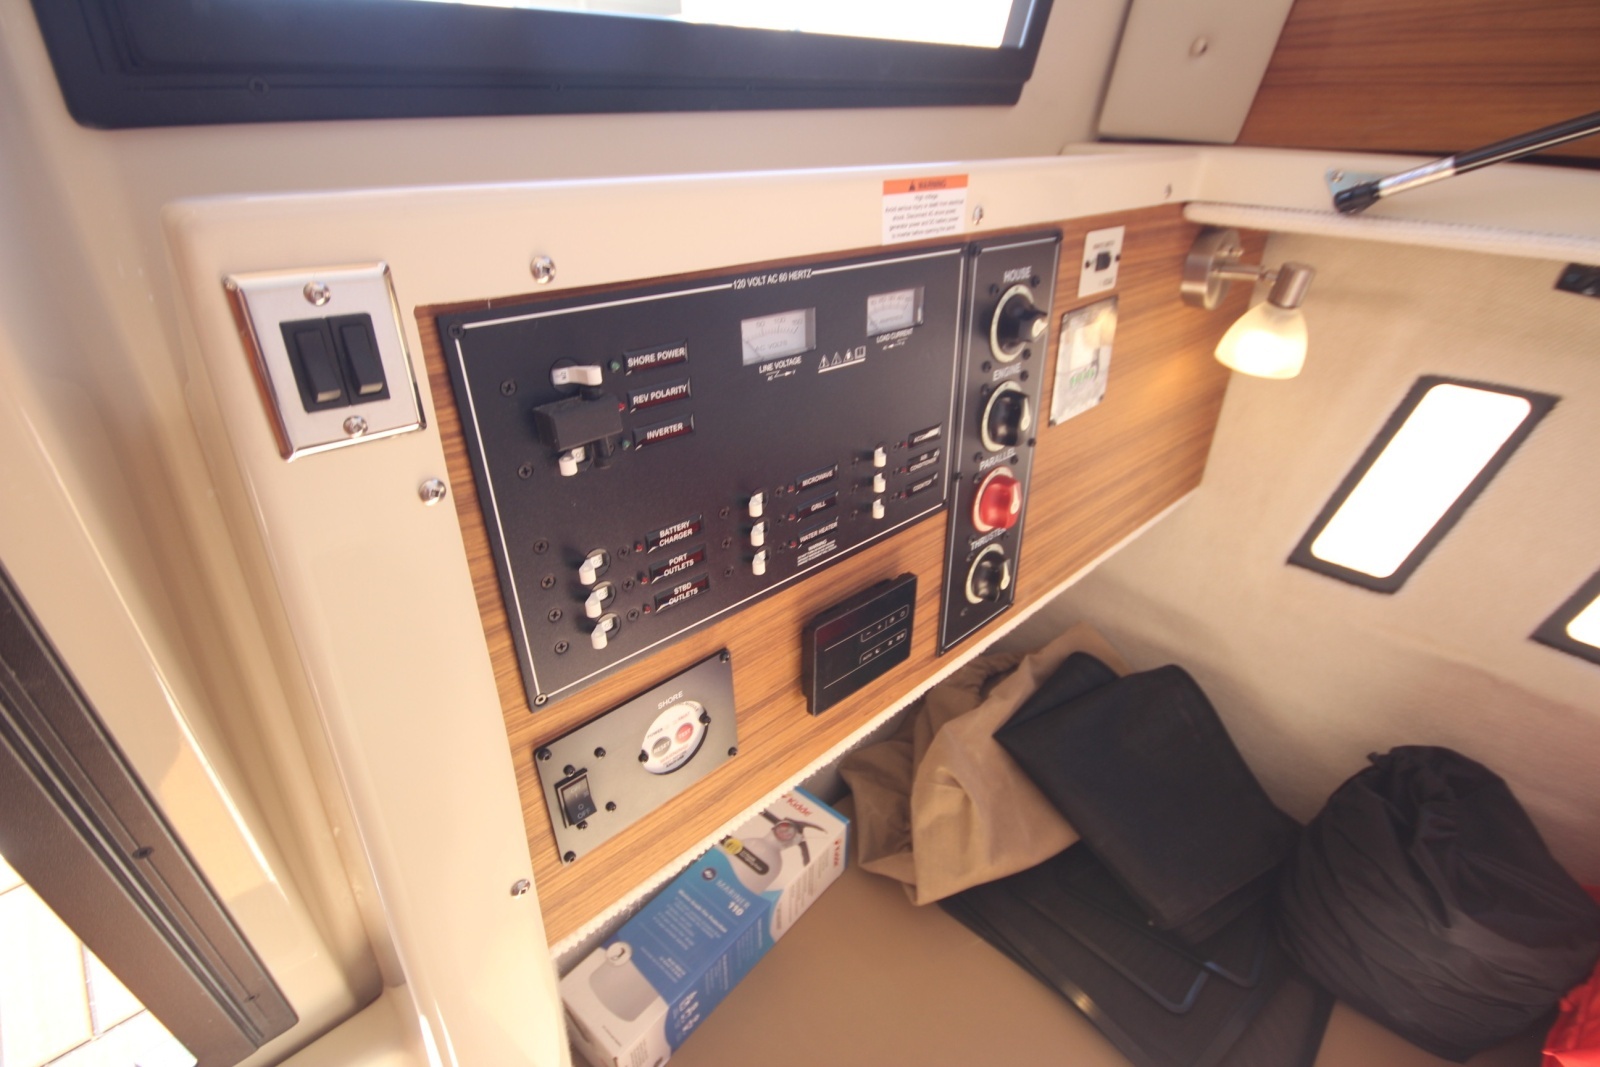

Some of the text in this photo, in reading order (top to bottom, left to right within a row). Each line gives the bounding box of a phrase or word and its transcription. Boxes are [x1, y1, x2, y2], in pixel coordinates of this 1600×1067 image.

[733, 268, 812, 290] 120 VOLT AC 60 HERTZ
[1003, 265, 1032, 283] HOUSE
[627, 346, 686, 368] SHORE POWER
[759, 355, 802, 374] LINE VOLTAGE
[993, 362, 1022, 382] ENGINE
[633, 383, 687, 405] REV POLARITY
[646, 422, 684, 440] INVERTER
[802, 469, 833, 487] MICROWAVE
[811, 500, 826, 512] GRILL
[659, 520, 691, 538] BATTERY
[659, 528, 693, 547] CHARGER
[800, 521, 838, 543] WATER HEATER
[663, 558, 694, 577] OUTLETS
[668, 552, 688, 566] PORT
[668, 587, 698, 605] OUTLETS
[673, 582, 692, 595] STBD
[657, 690, 684, 710] SHORE
[653, 740, 670, 754] RESET
[787, 797, 812, 817] Kidde
[728, 901, 744, 916] 110
